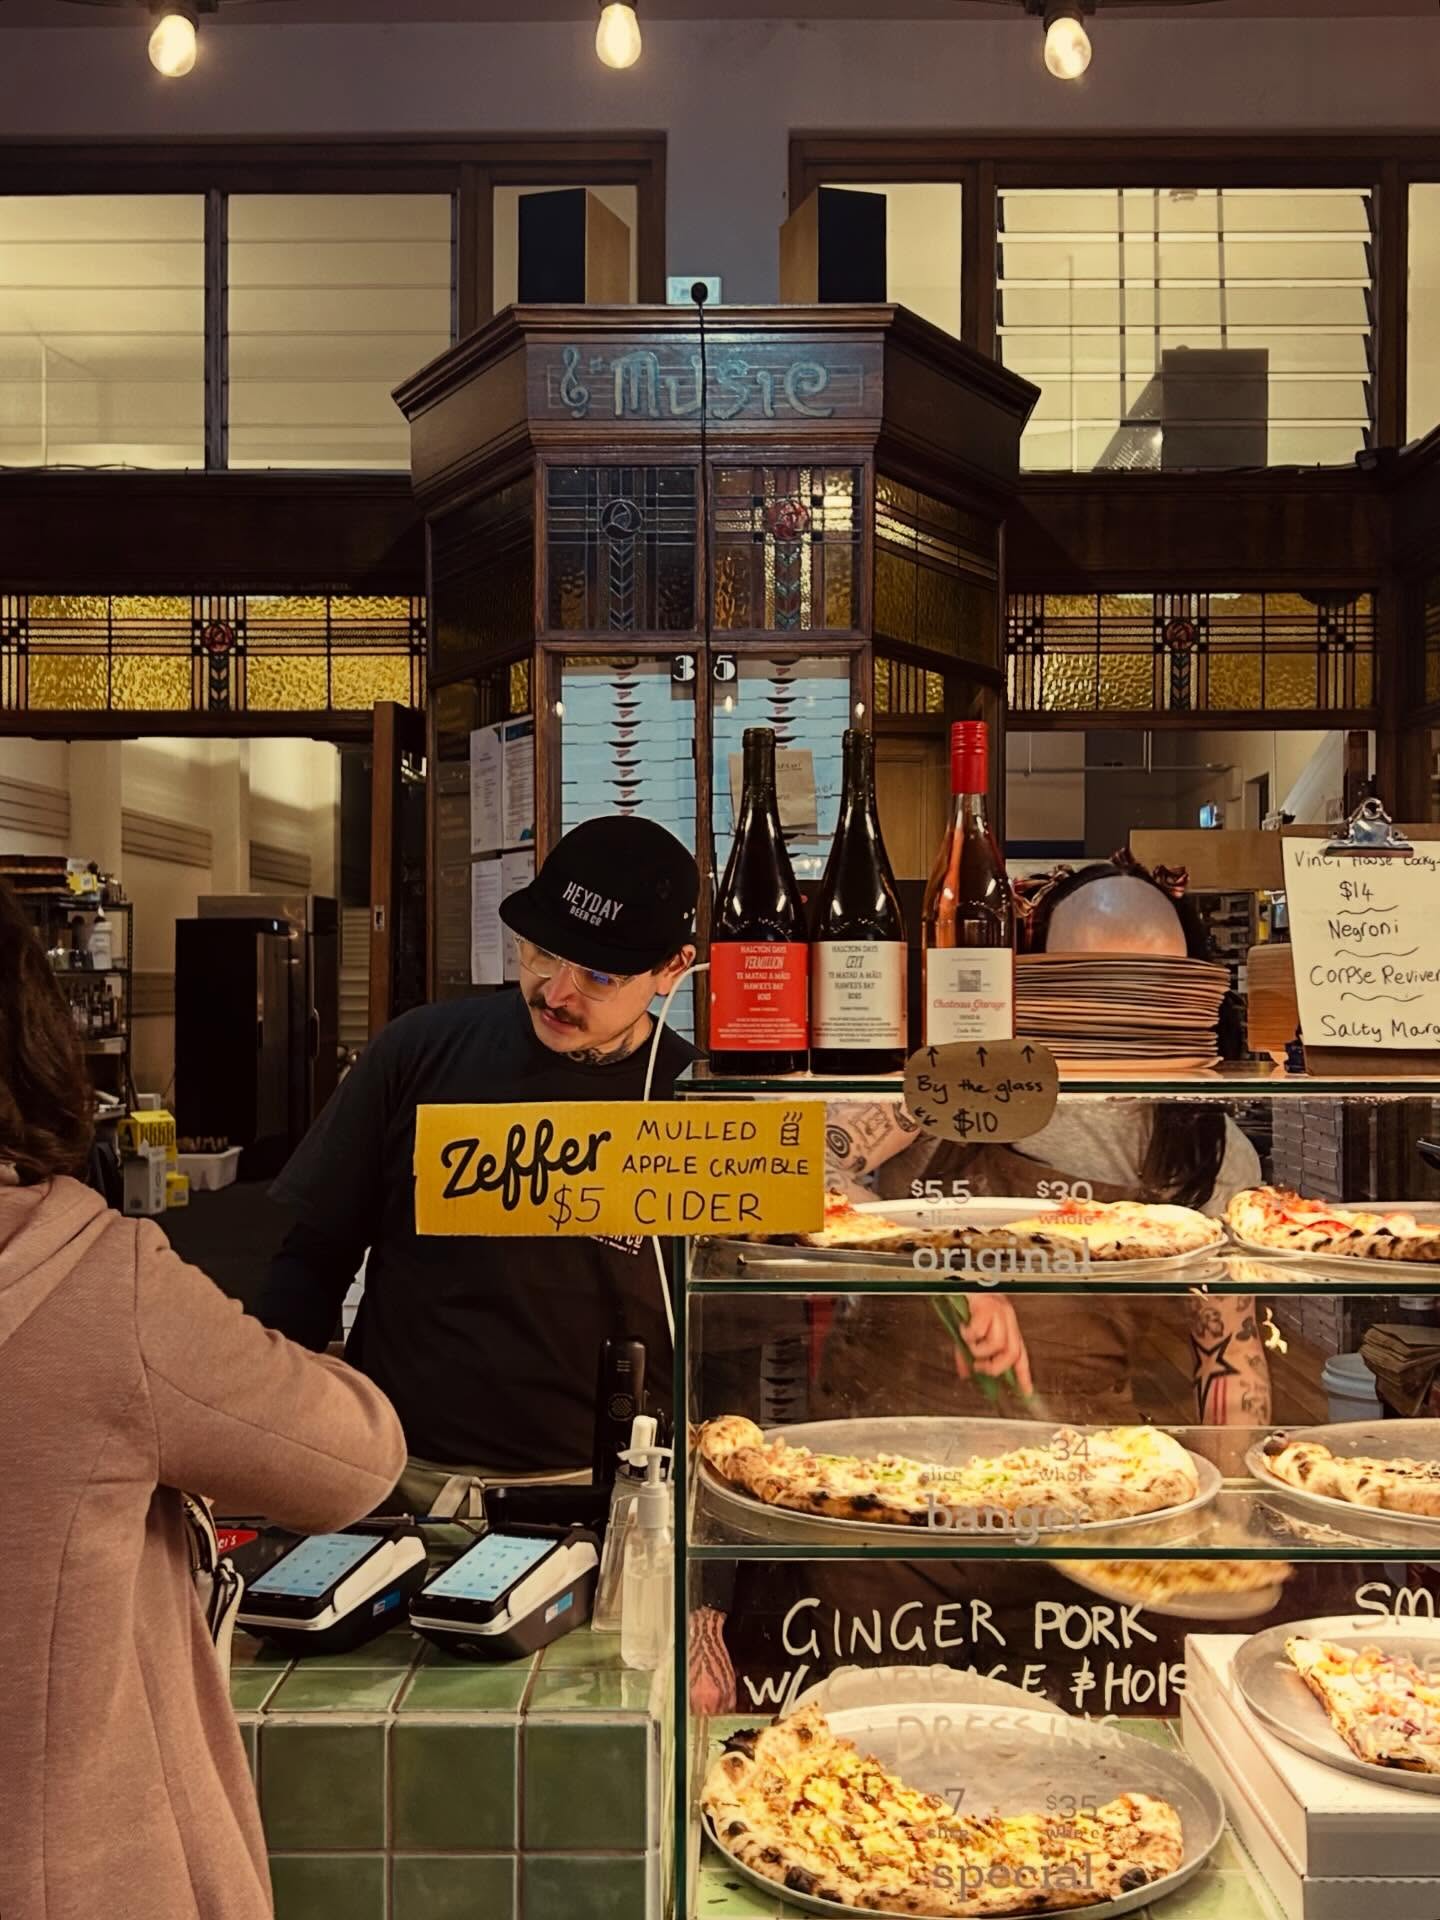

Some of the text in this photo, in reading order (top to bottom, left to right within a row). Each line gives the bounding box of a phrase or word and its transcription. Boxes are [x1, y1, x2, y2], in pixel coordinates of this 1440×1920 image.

[673, 655, 736, 681] 3 5
[562, 881, 624, 921] HEYDAY
[1339, 880, 1374, 901] $14
[569, 905, 590, 921] BEER
[1328, 919, 1400, 942] Negroni
[1320, 1014, 1383, 1042] Salty
[916, 1074, 1044, 1104] By the glass
[636, 1119, 757, 1142] MULLED
[952, 1108, 998, 1139] $10
[440, 1118, 612, 1211] Zeffer
[621, 1154, 810, 1177] APPLE CRUMBLE
[1036, 1179, 1094, 1205] $30
[547, 1183, 764, 1232] $5 CIDER
[912, 1236, 1093, 1288] original
[924, 1493, 1090, 1546] banger
[782, 1597, 1159, 1659] GINGER PORK
[896, 1712, 1126, 1762] DRESSING
[1045, 1794, 1098, 1820] $35
[932, 1853, 1095, 1903] special
